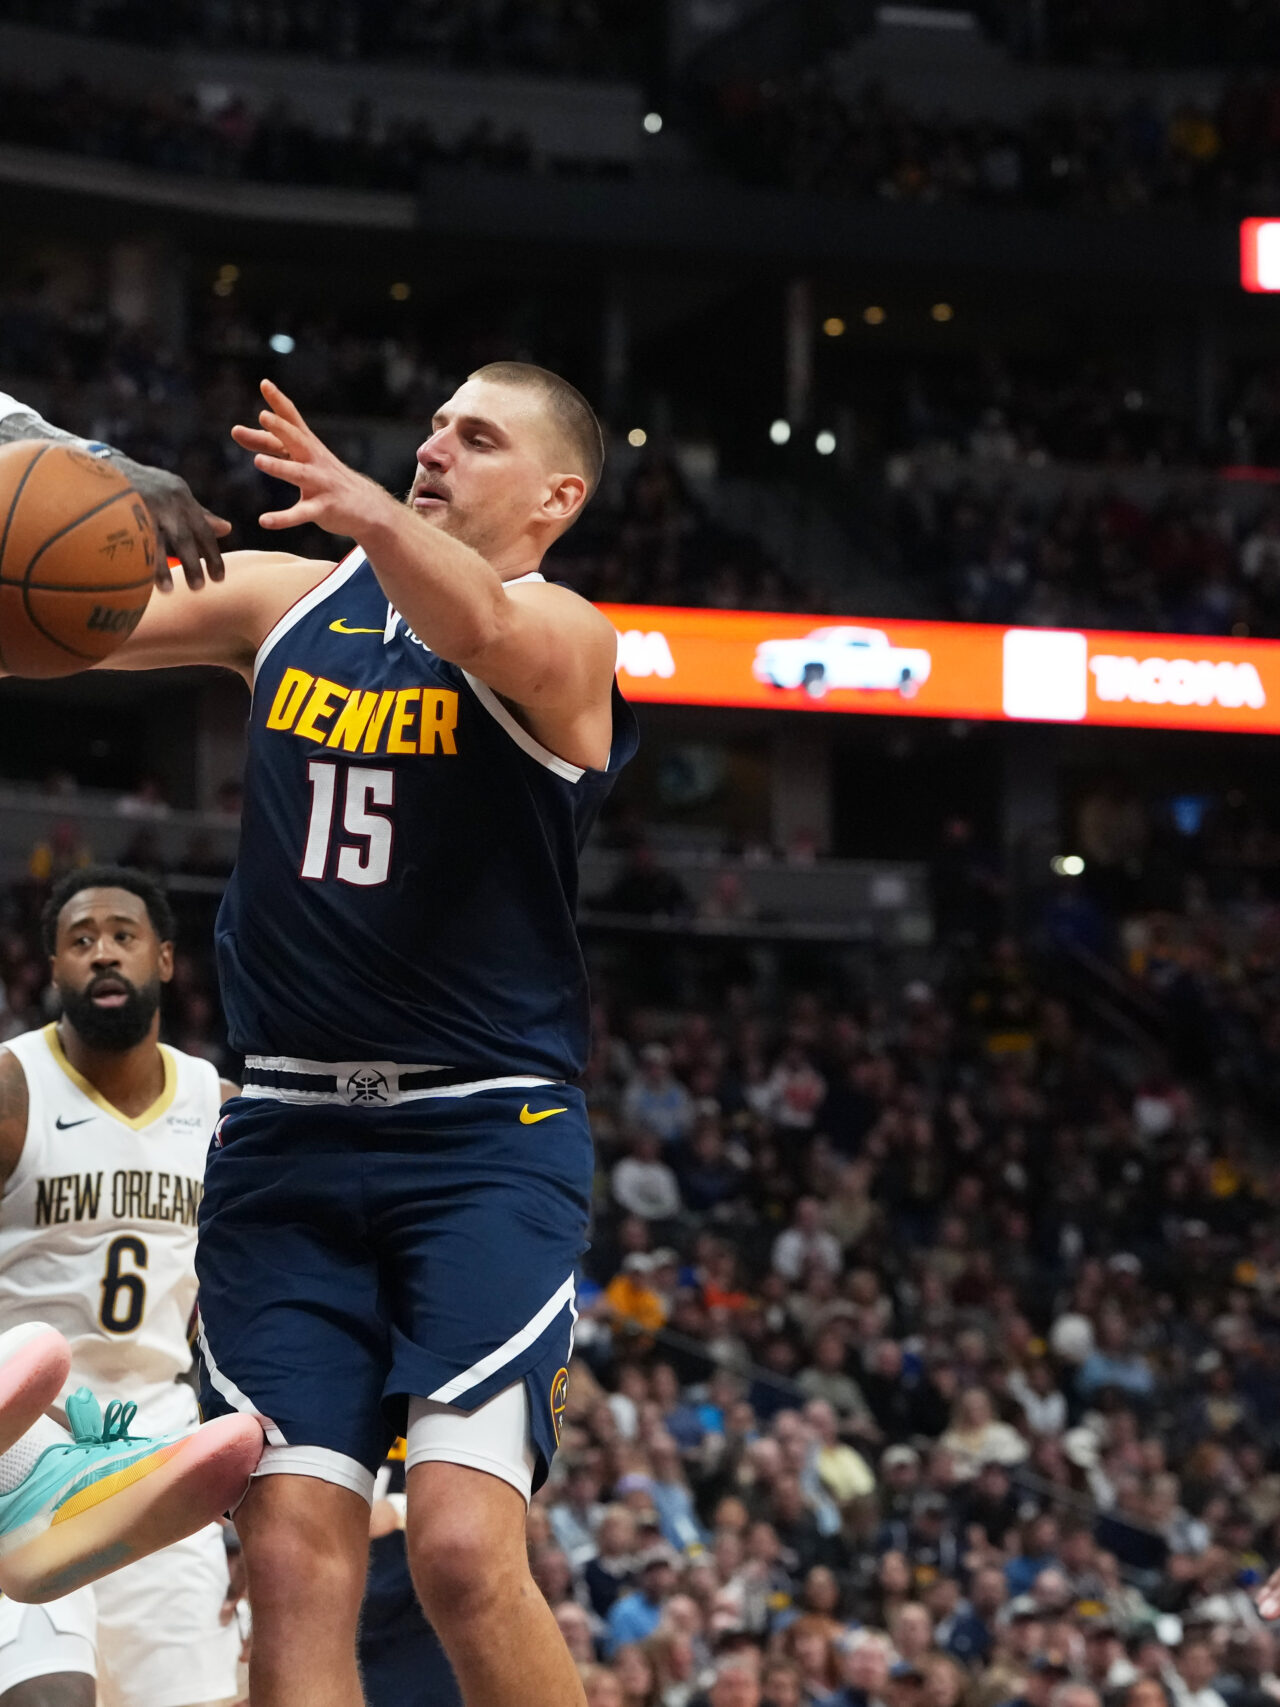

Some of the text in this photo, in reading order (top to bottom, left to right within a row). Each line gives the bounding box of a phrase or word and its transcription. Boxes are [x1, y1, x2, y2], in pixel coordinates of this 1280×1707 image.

[265, 666, 460, 755] DENVER
[299, 759, 395, 887] 15
[35, 1169, 204, 1227] NEW ORLEAN
[99, 1234, 149, 1335] 6
